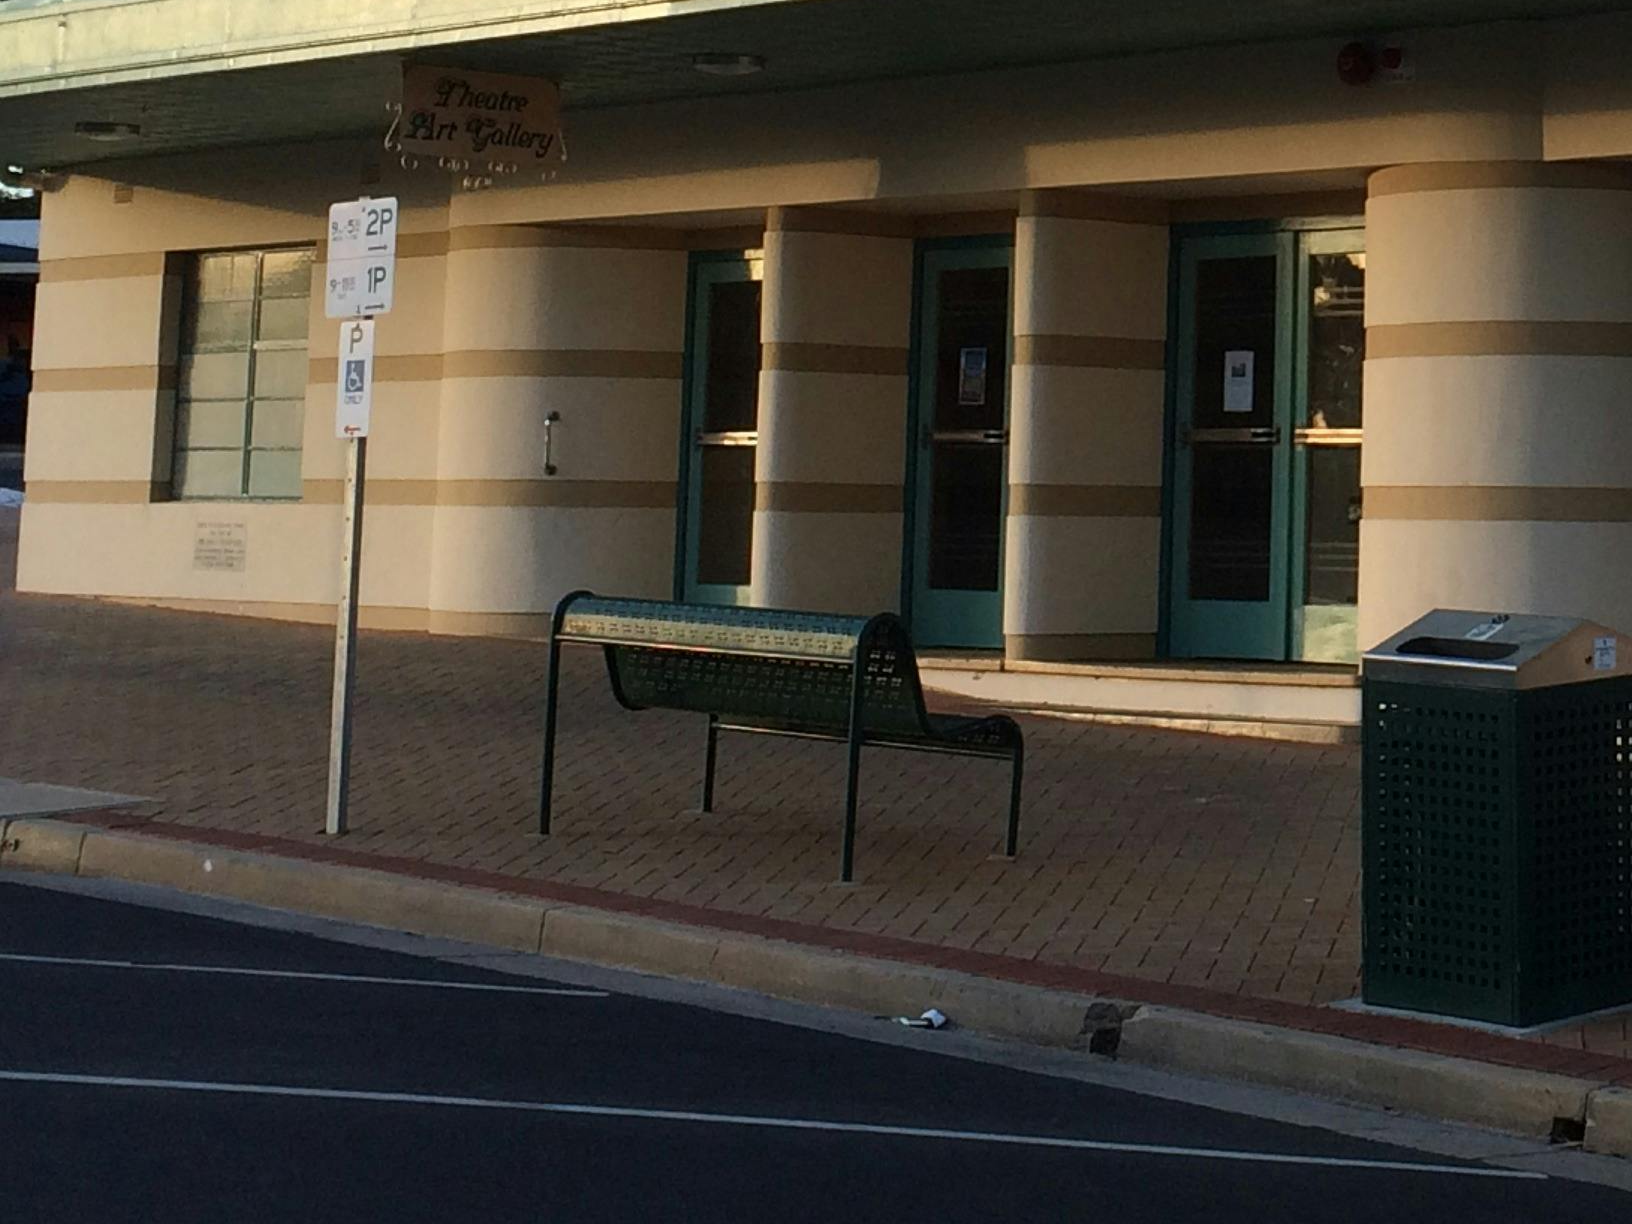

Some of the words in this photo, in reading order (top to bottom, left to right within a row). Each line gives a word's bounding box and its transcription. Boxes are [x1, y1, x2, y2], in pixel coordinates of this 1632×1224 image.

[433, 77, 529, 113] Theatre
[404, 111, 458, 141] Art
[464, 114, 554, 159] Gallery
[366, 207, 394, 236] 2P
[367, 266, 387, 294] 1P
[349, 326, 364, 354] P
